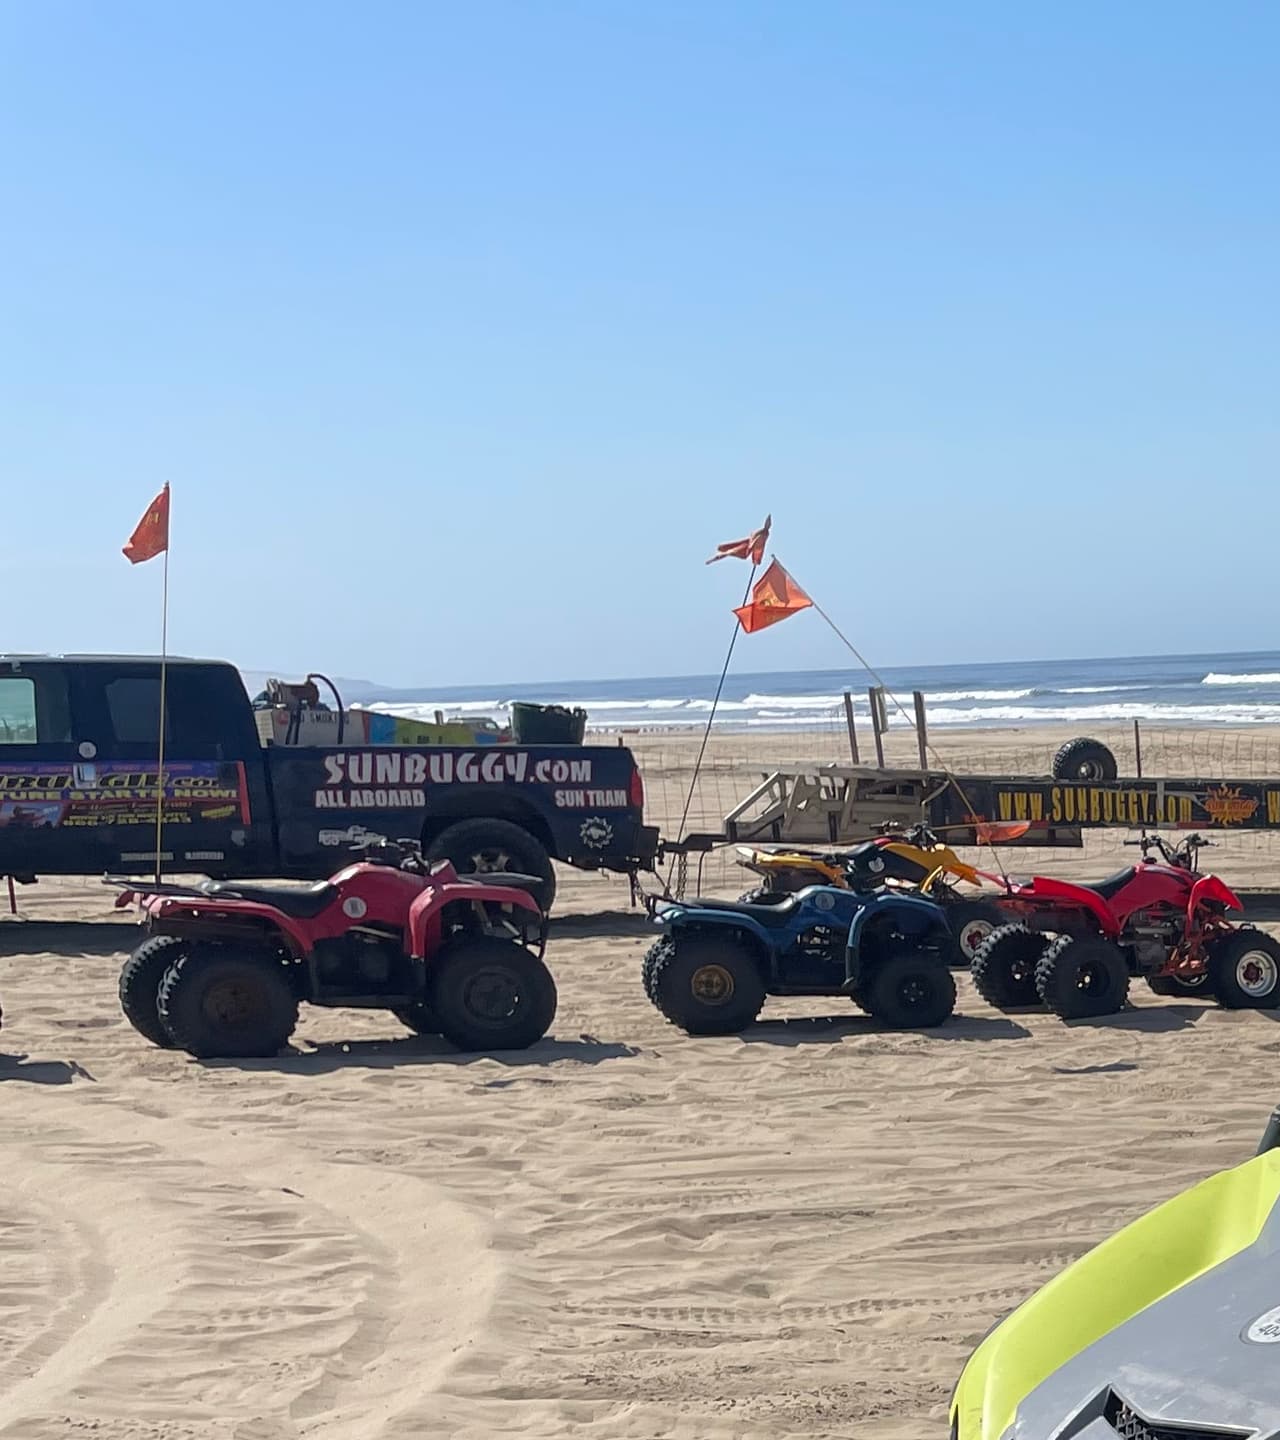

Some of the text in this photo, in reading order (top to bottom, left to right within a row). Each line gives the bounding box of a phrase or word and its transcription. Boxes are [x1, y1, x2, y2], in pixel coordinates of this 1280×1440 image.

[69, 789, 166, 800] STARTS
[174, 788, 238, 799] NOW!
[315, 789, 628, 808] ALL ABOARD SUN TRAM
